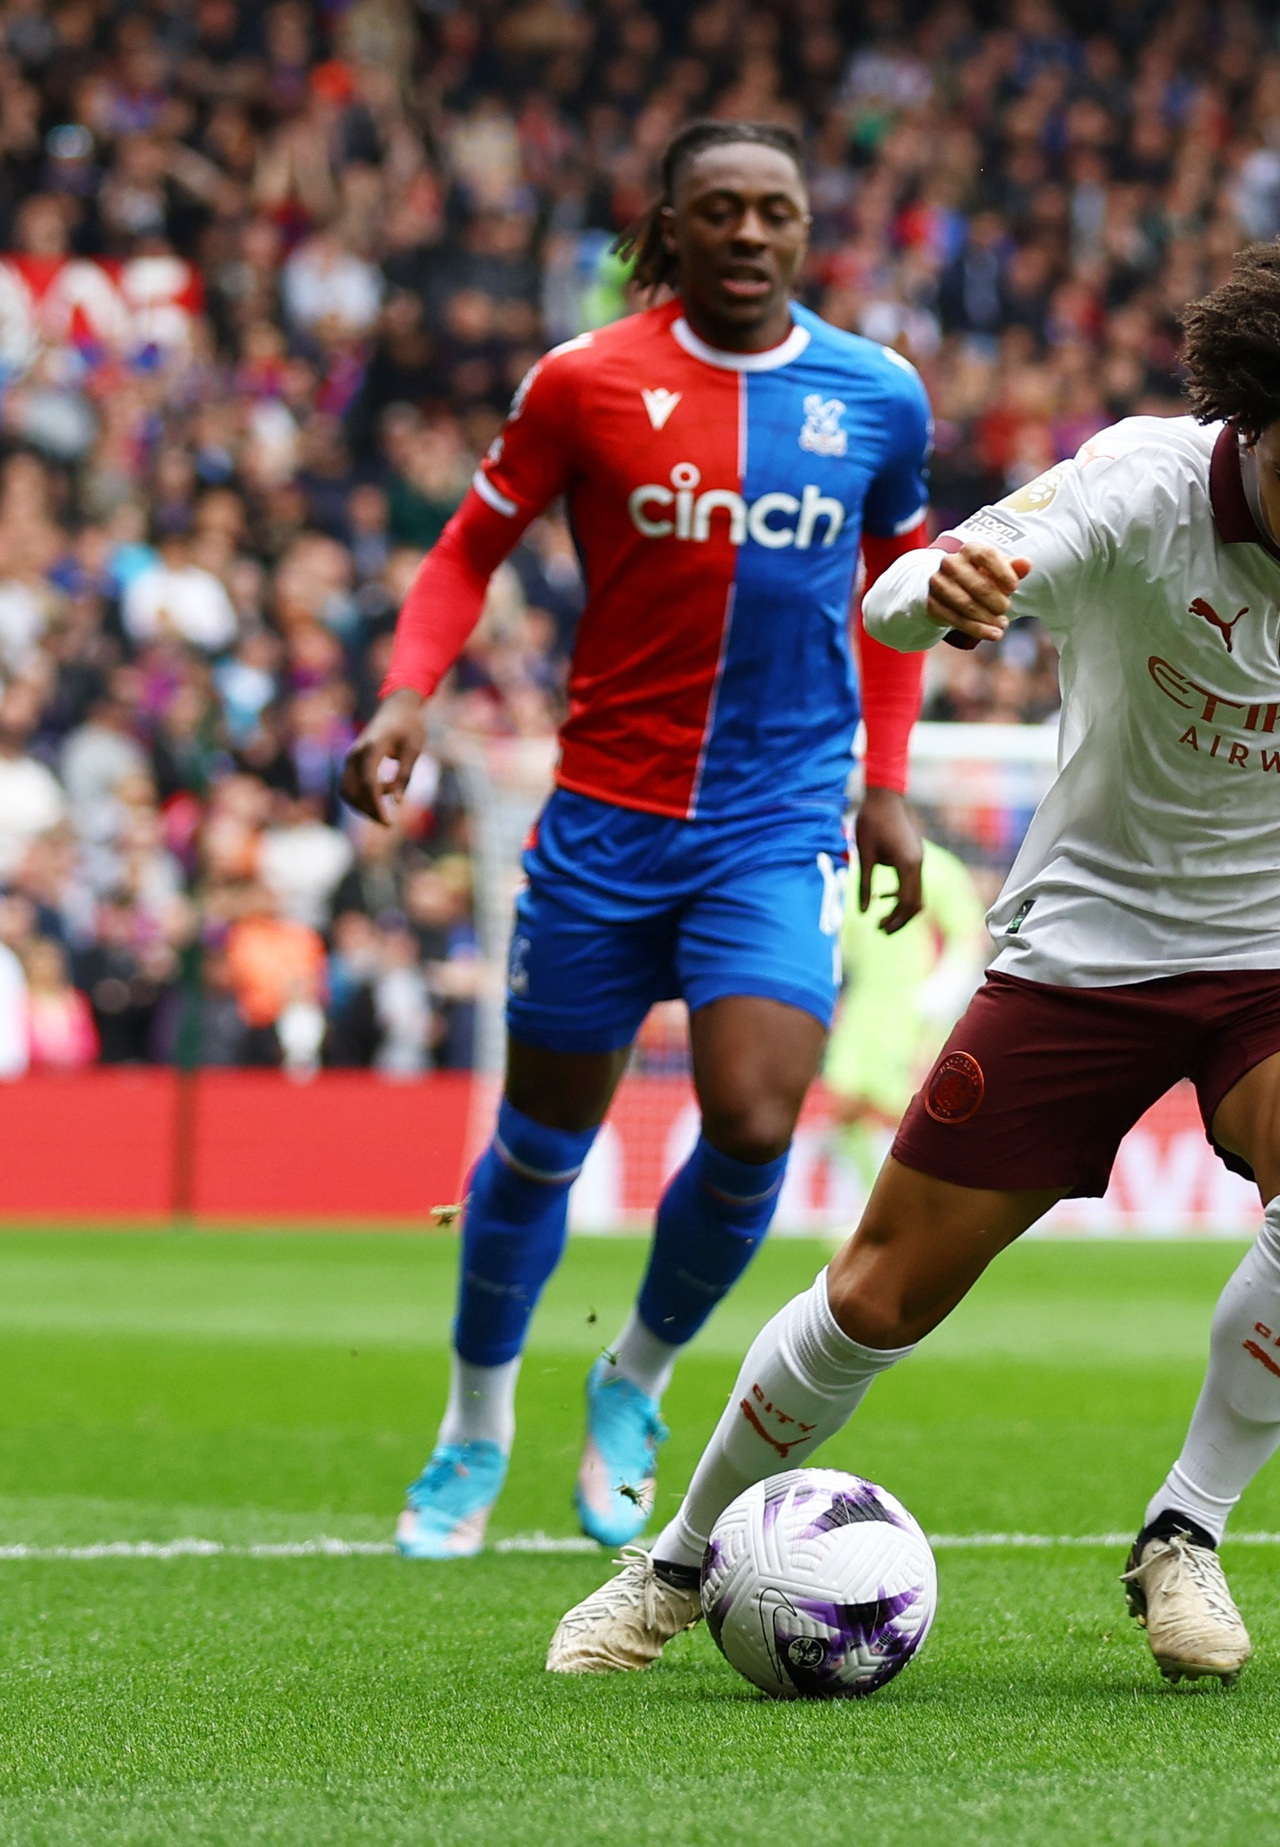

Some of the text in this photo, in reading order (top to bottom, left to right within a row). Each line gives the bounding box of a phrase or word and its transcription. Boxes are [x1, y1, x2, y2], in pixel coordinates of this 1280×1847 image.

[628, 462, 844, 549] cinch
[978, 514, 1018, 538] room
[753, 1383, 818, 1432] CITY
